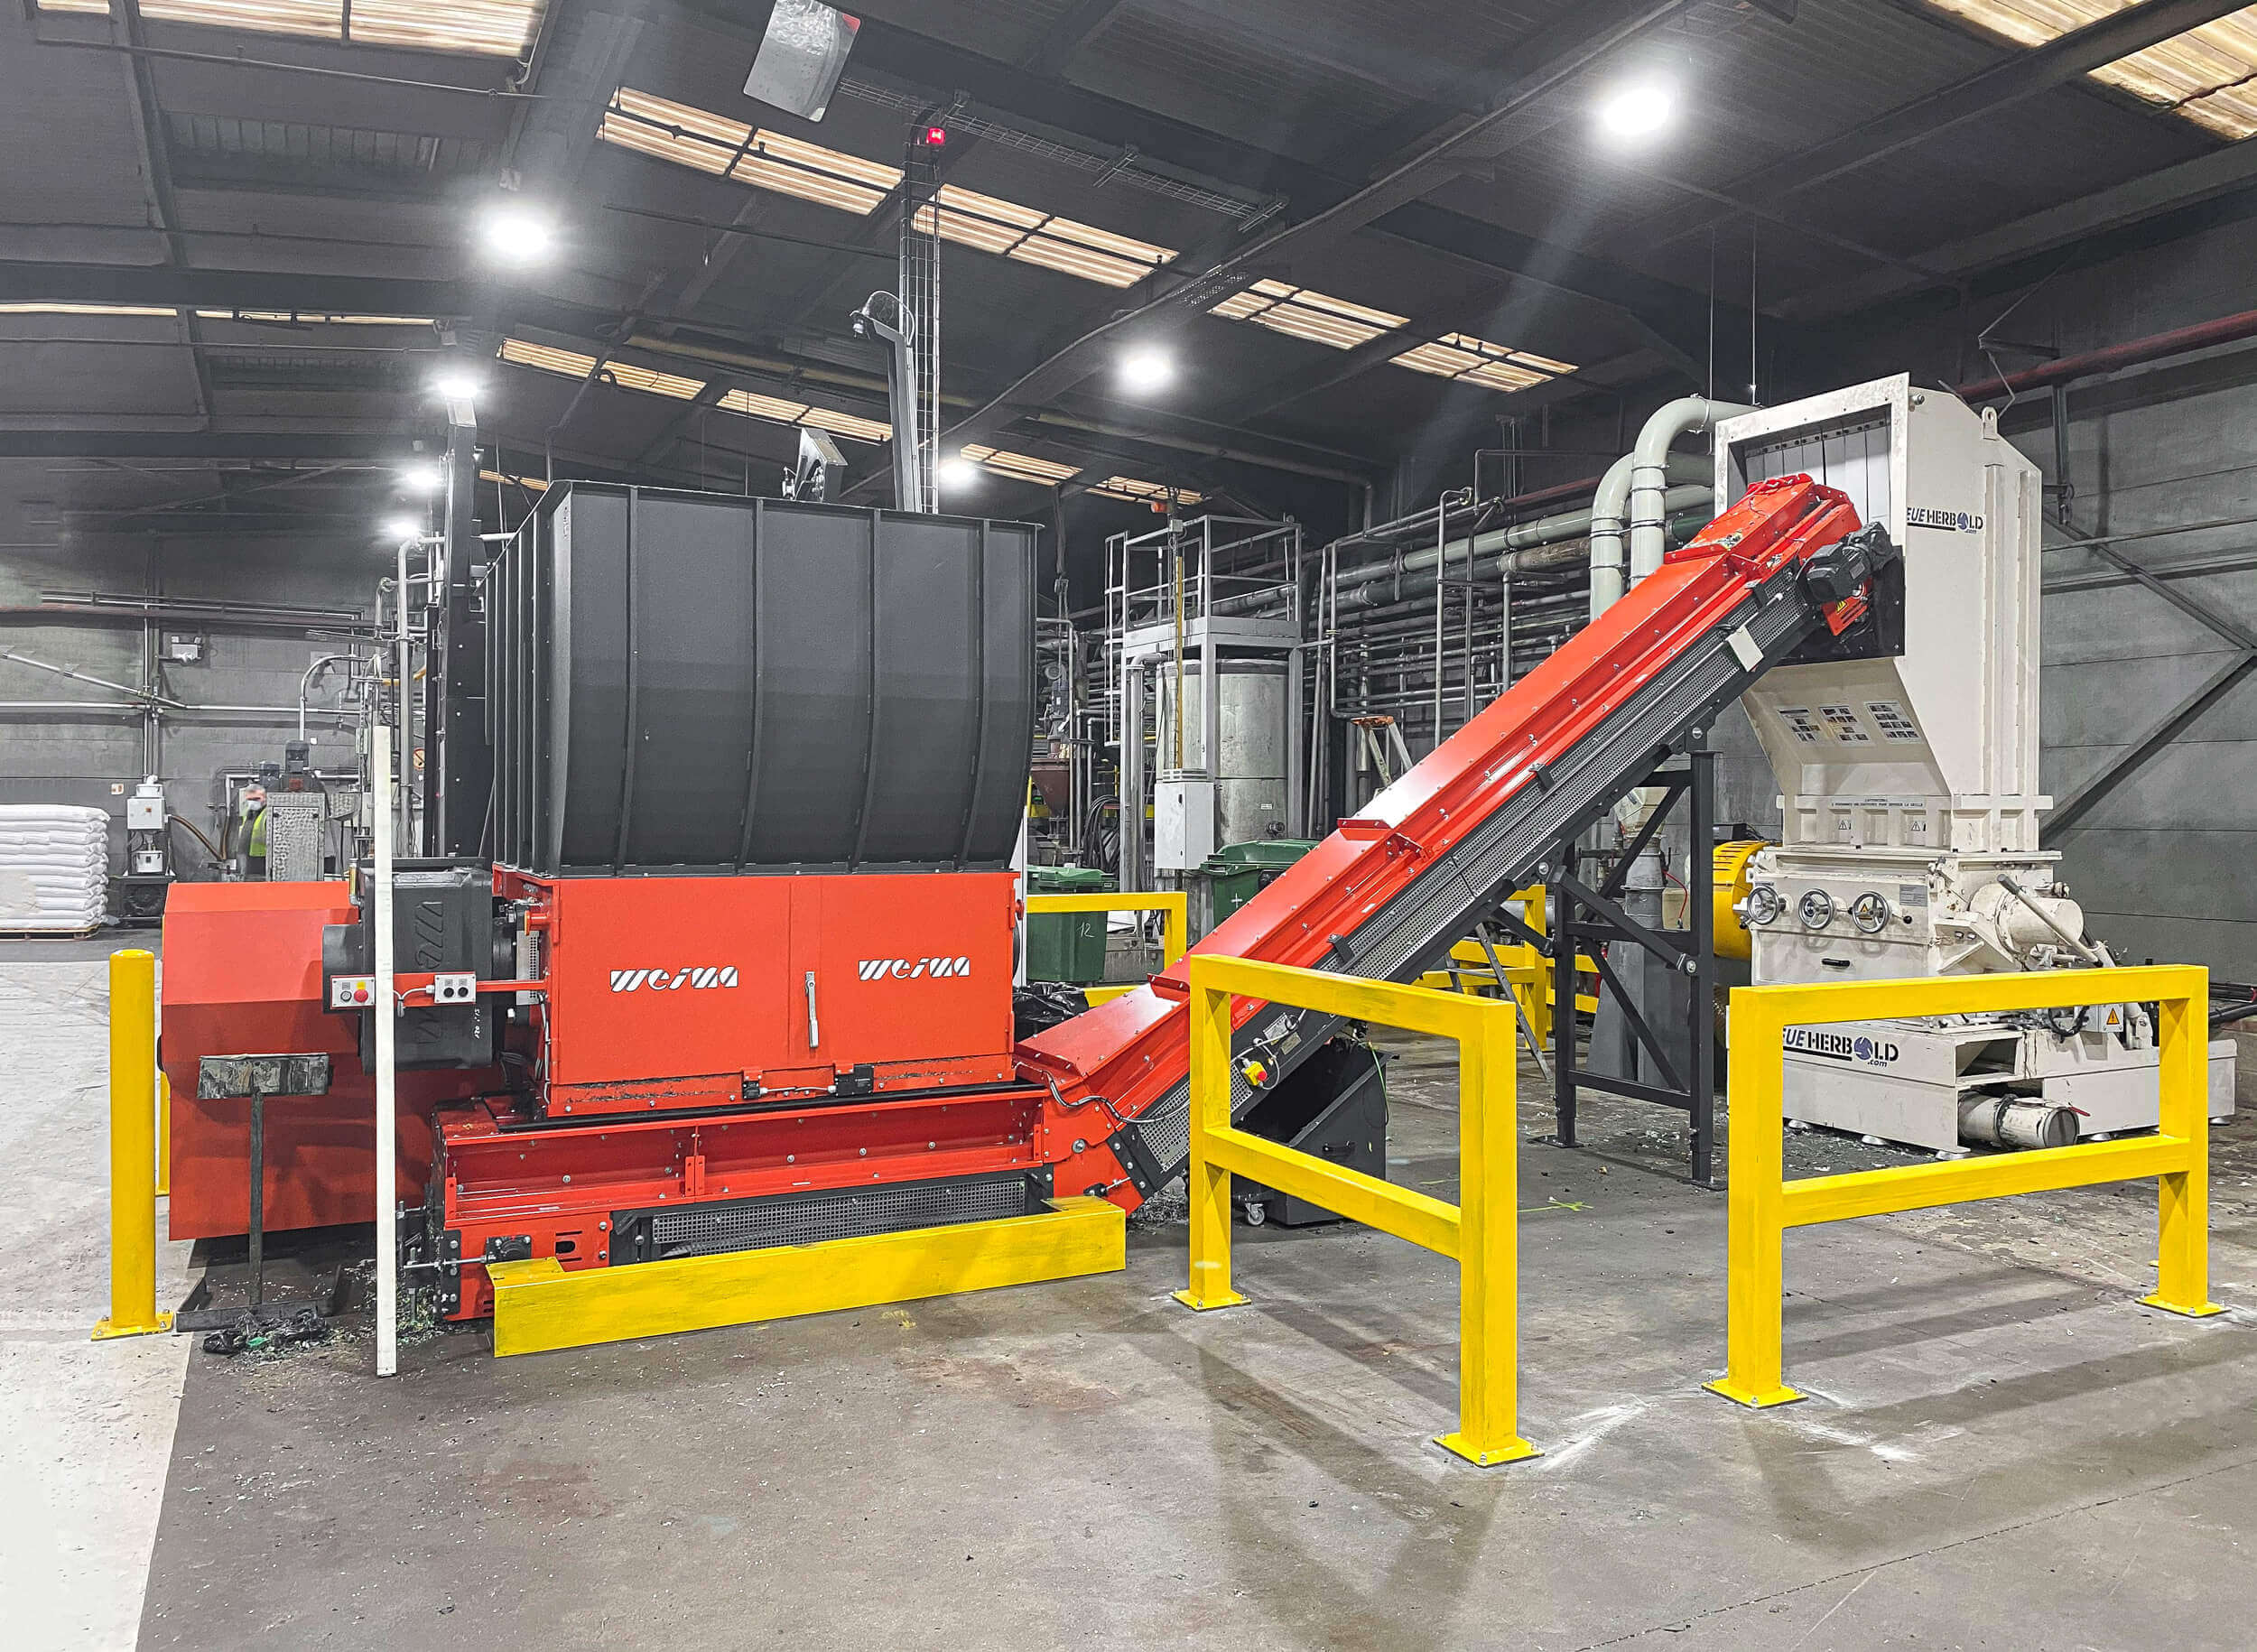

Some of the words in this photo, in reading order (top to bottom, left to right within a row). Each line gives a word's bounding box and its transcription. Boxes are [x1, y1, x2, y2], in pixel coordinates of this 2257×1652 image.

[1076, 922, 1095, 938] 12
[859, 956, 971, 981] weima
[609, 965, 739, 993] weima
[1867, 1059, 1888, 1068] .com
